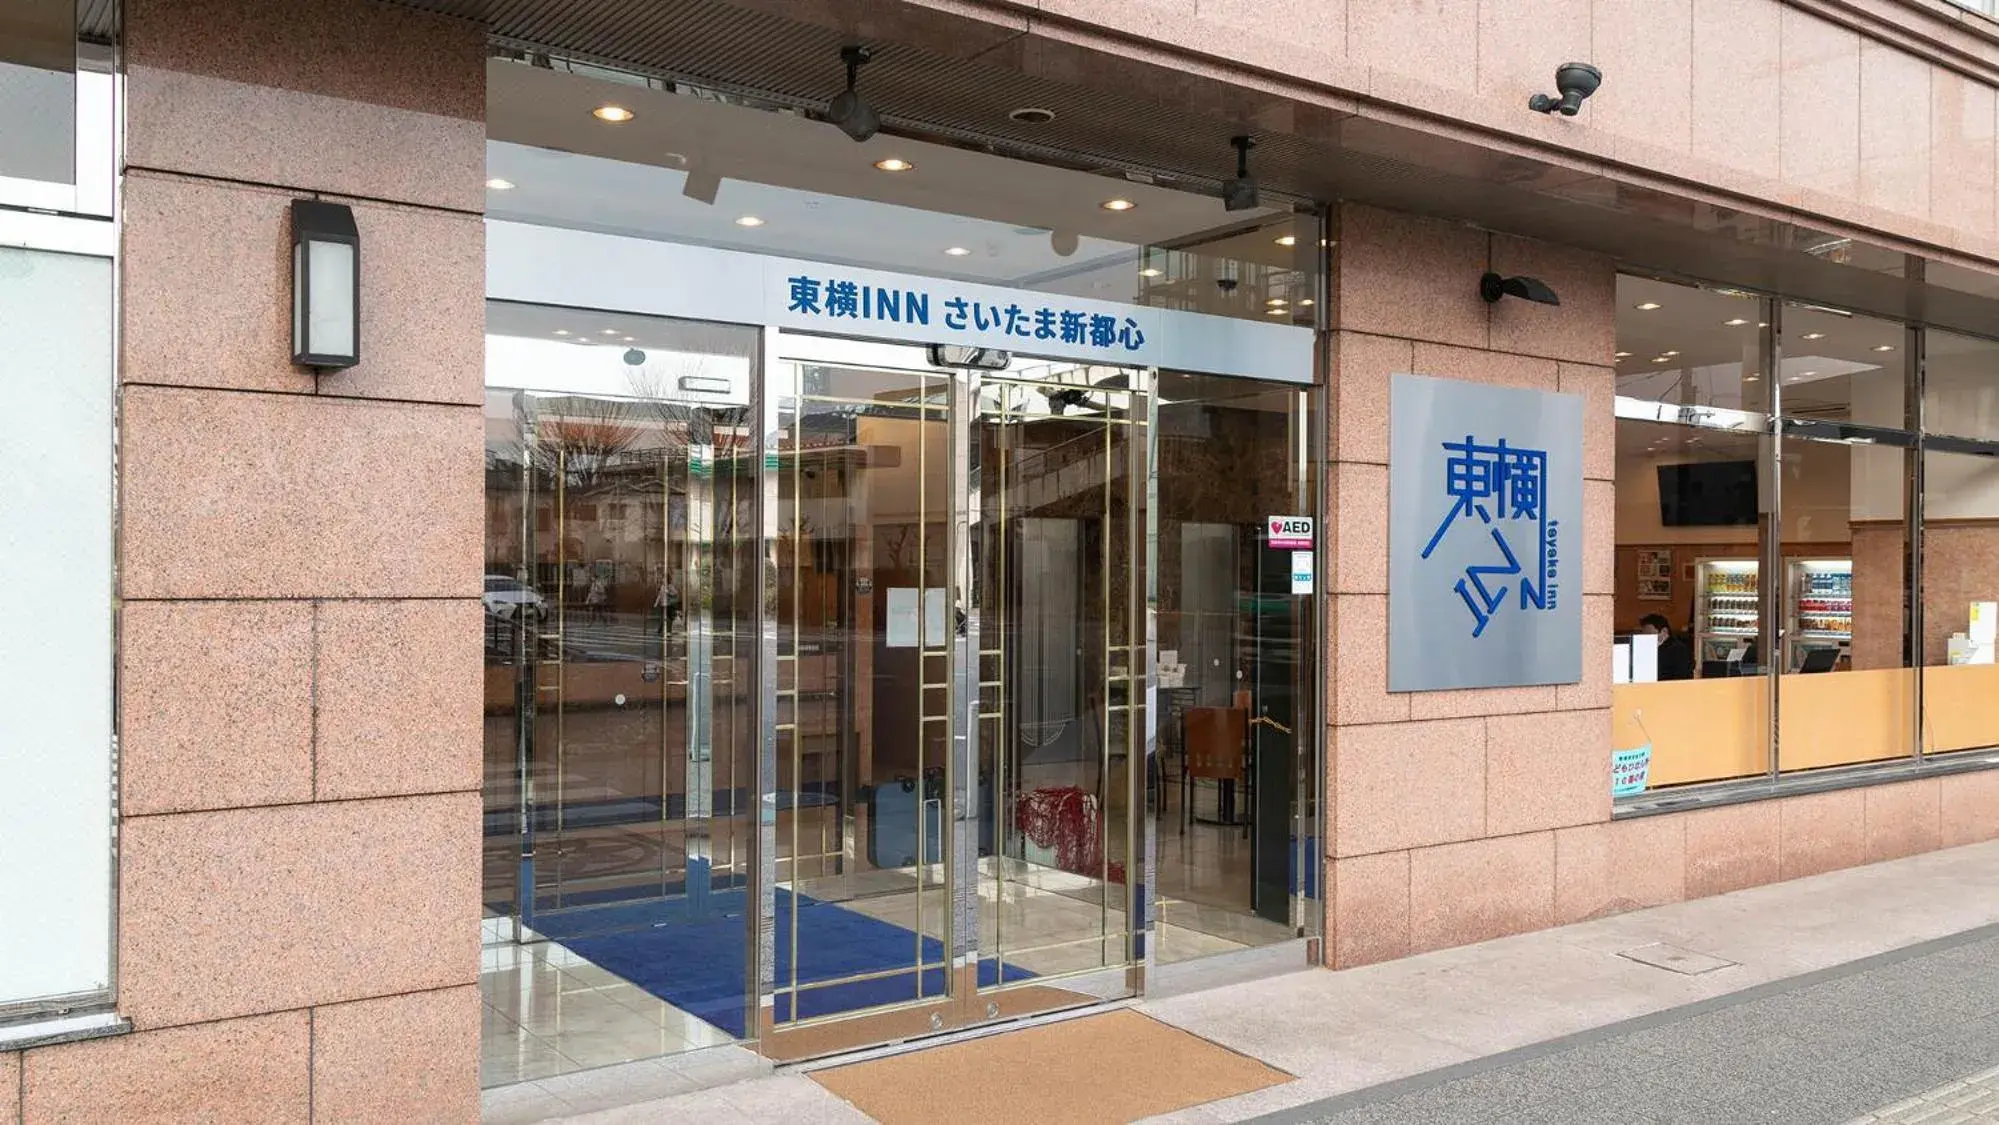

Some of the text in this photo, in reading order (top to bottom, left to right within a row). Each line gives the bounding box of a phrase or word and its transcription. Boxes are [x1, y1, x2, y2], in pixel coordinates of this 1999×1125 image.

[788, 275, 1145, 351] 東横INN さいたま新都心
[1283, 521, 1310, 533] AED
[1546, 520, 1559, 610] toyoko inn
